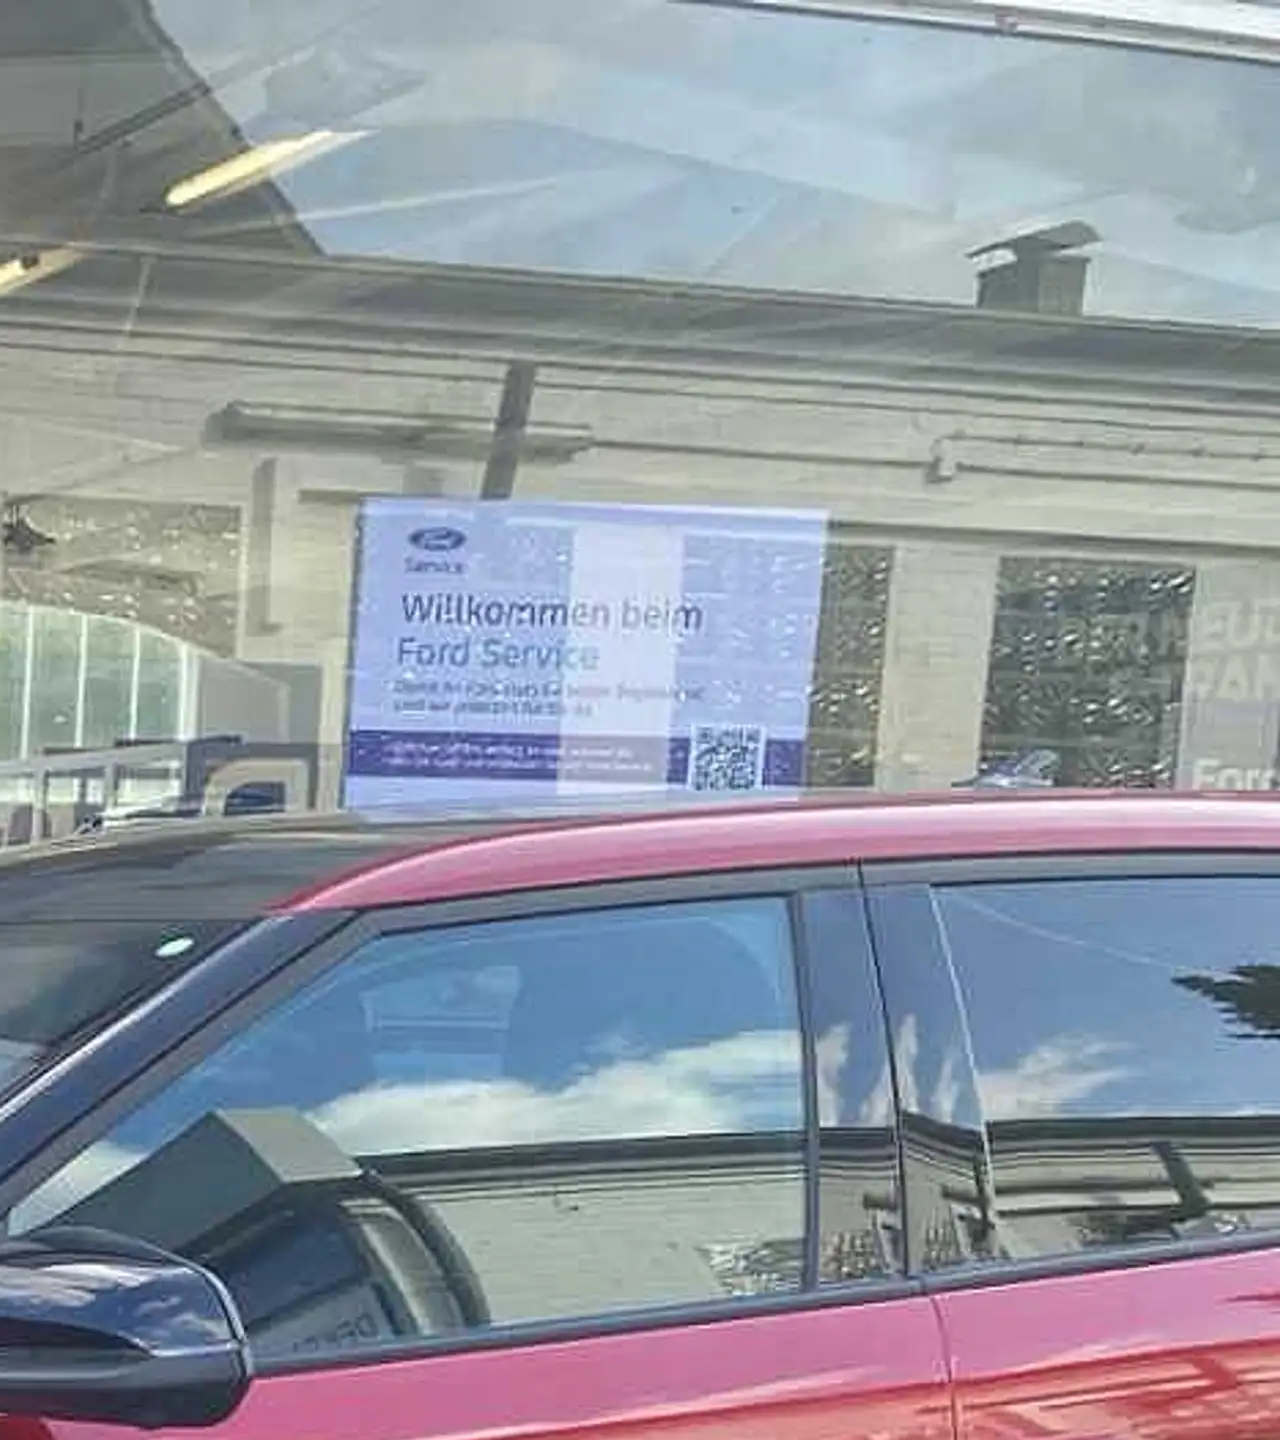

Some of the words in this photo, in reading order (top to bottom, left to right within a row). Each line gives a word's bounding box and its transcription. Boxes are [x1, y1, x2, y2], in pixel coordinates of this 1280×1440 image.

[402, 592, 610, 628] Willkommen
[622, 602, 704, 631] beim
[396, 638, 470, 668] Ford
[481, 638, 600, 671] Service
